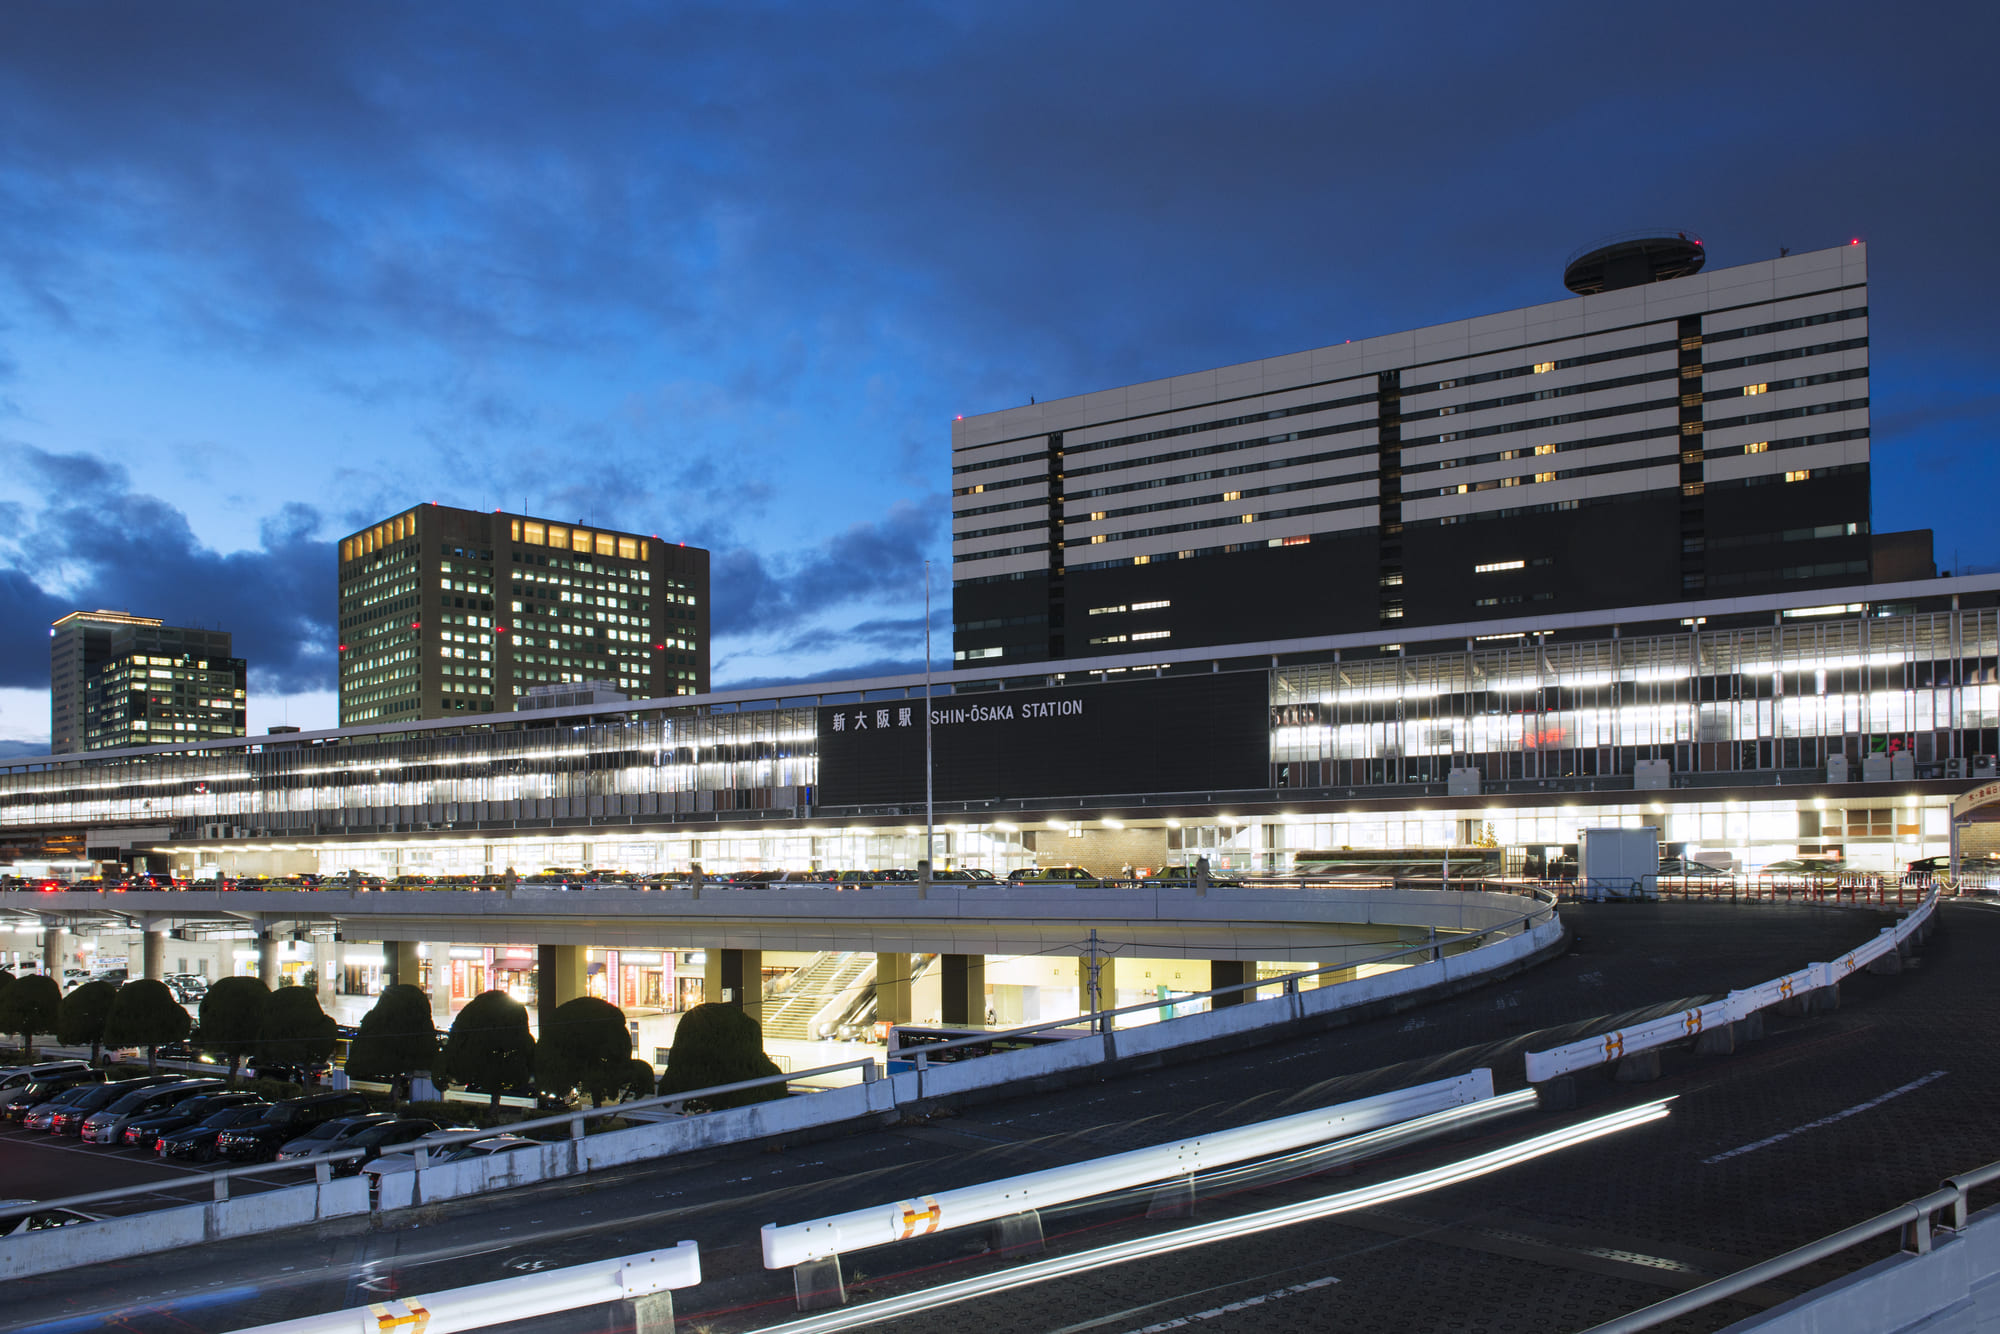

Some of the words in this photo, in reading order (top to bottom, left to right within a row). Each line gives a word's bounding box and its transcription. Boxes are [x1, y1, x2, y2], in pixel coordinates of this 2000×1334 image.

[832, 707, 912, 732] 新大阪駅
[930, 704, 1014, 725] SHIN-ŌSAKA
[1022, 700, 1083, 718] STATION
